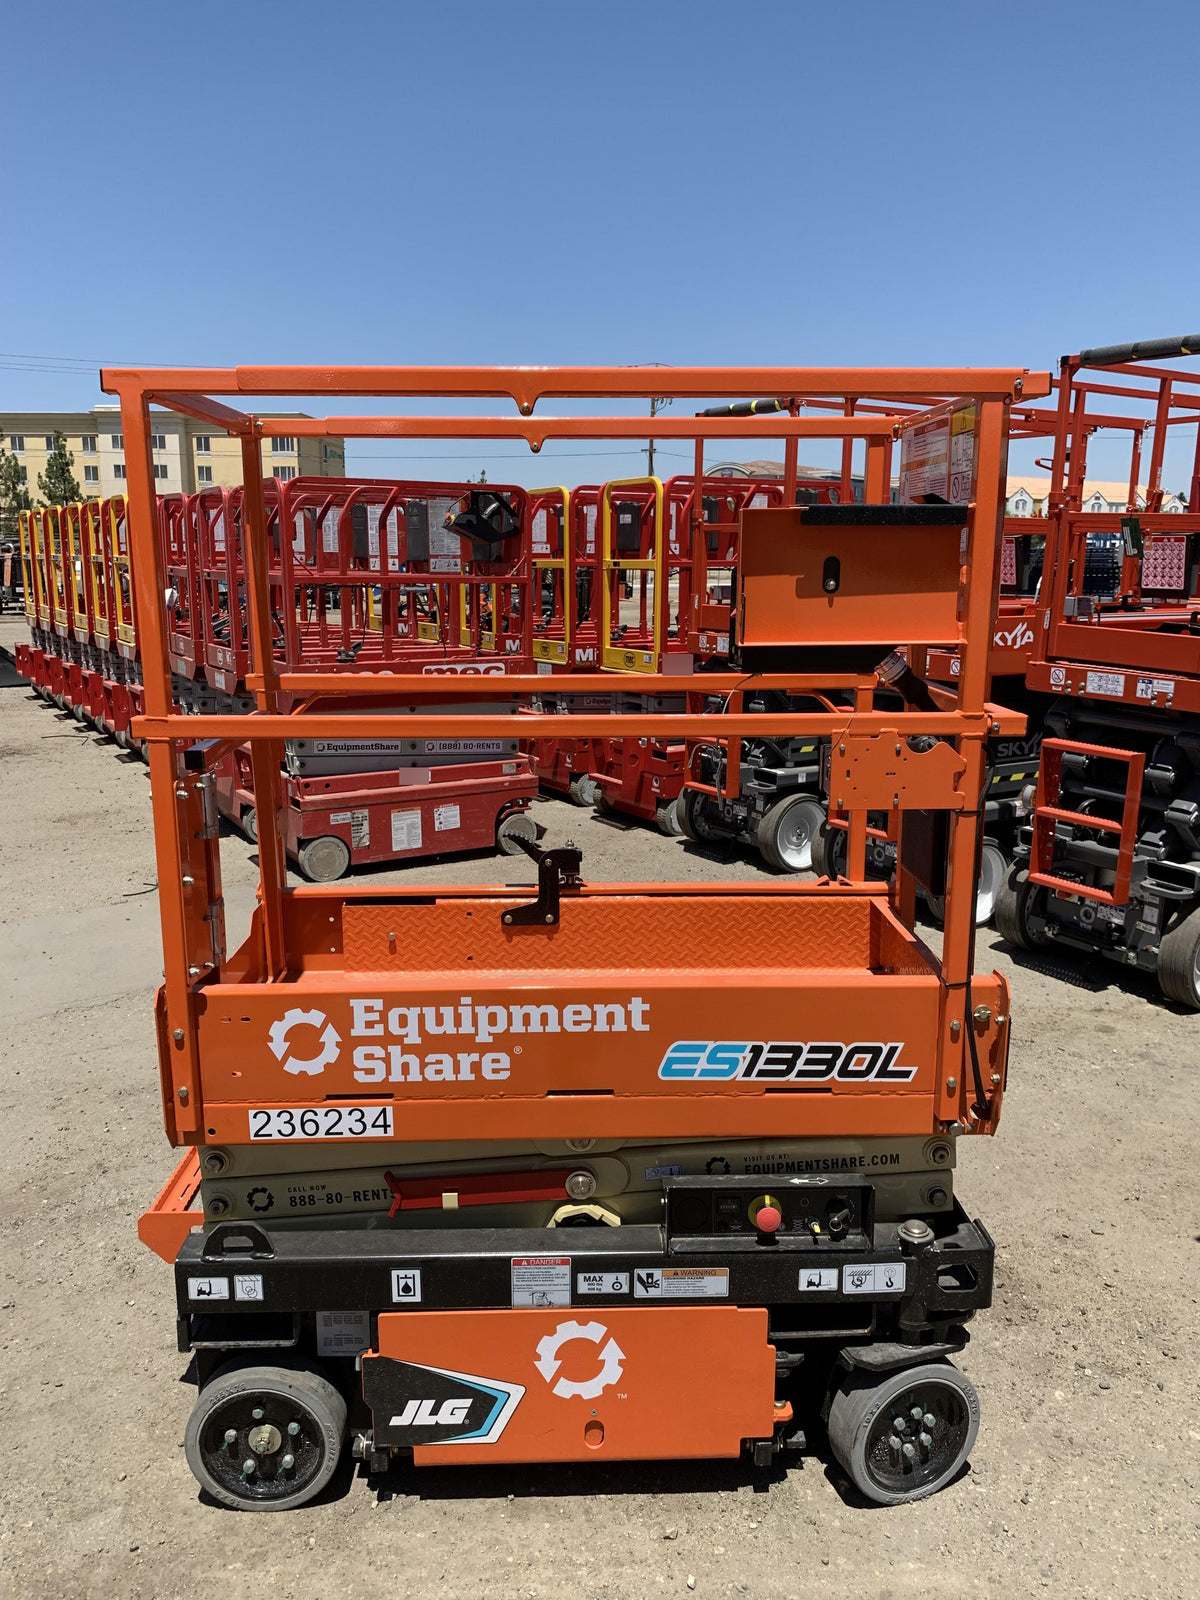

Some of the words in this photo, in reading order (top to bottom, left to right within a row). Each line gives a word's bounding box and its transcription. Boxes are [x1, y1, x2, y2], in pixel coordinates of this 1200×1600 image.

[326, 742, 399, 753] EquipmentShare
[438, 741, 461, 751] (888)
[349, 996, 651, 1045] Equipment
[659, 1040, 917, 1081] ES1330L
[251, 1106, 392, 1138] 236234
[744, 1153, 900, 1174] EQUIPMENTSHARE.COM
[287, 1185, 307, 1193] CALL
[310, 1184, 327, 1192] NOW
[583, 1275, 604, 1283] MAX
[389, 1398, 474, 1427] JLG
